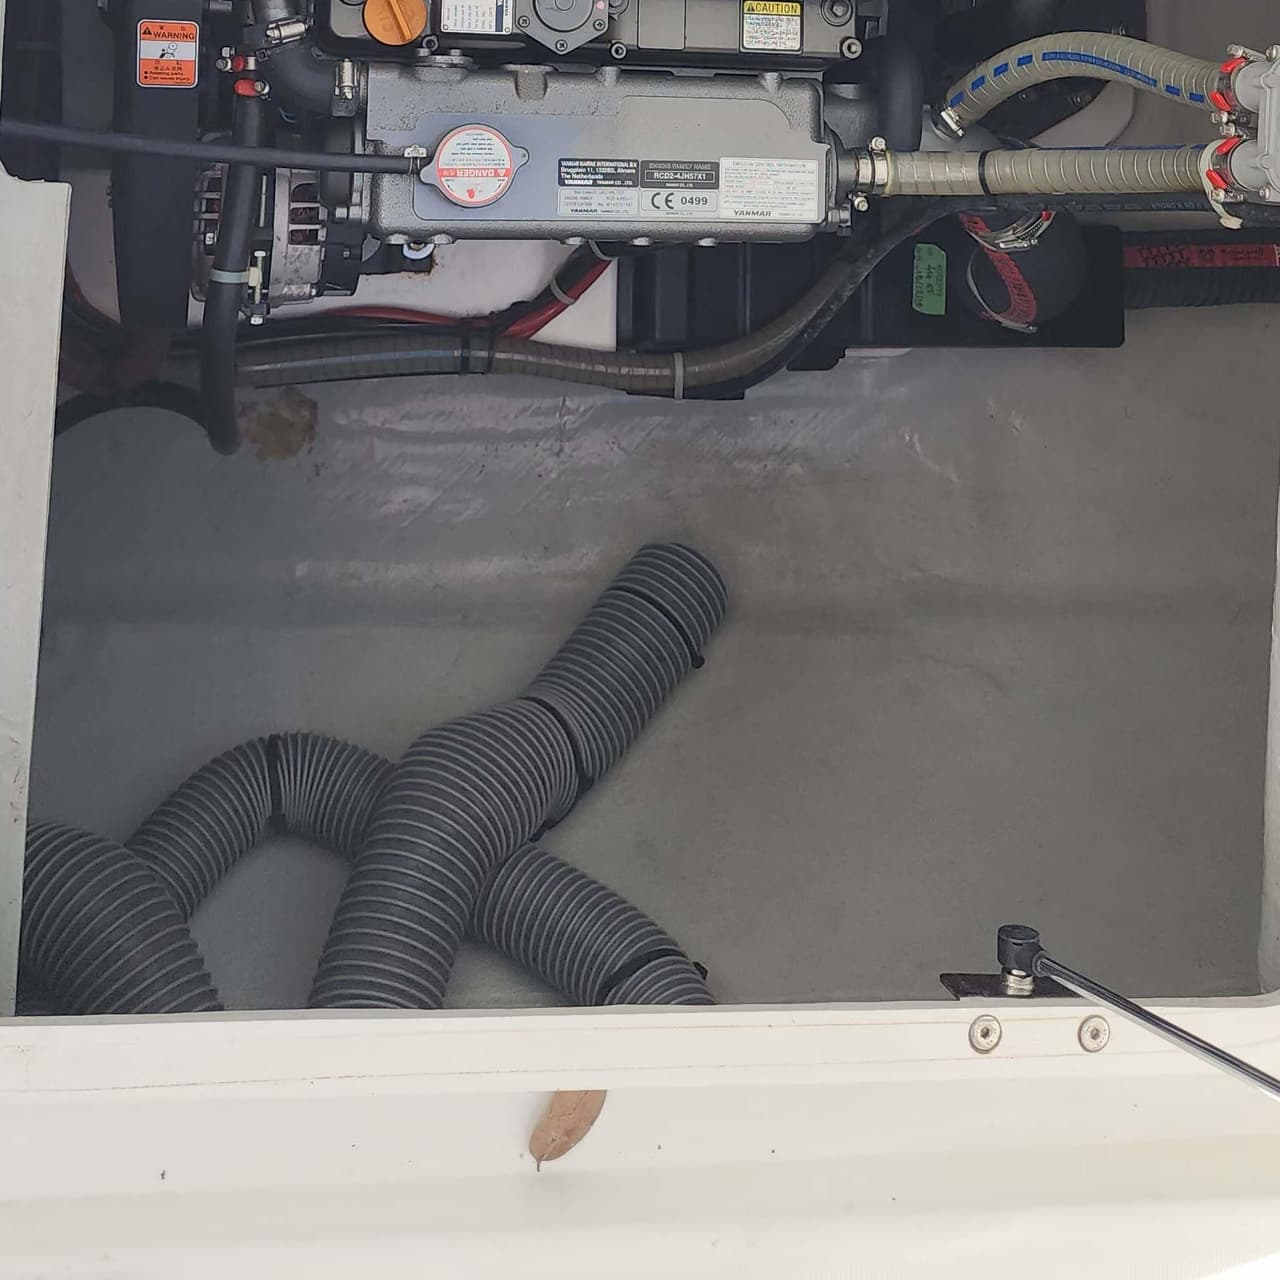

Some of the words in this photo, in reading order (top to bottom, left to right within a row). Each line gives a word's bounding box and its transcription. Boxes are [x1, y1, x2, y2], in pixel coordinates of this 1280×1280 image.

[755, 2, 798, 13] CAUTION
[153, 32, 195, 40] WARNING
[456, 168, 495, 177] DANGER
[653, 172, 706, 180] RCD2-4JH57X1
[680, 196, 708, 205] 0499
[733, 209, 772, 217] YANMAR
